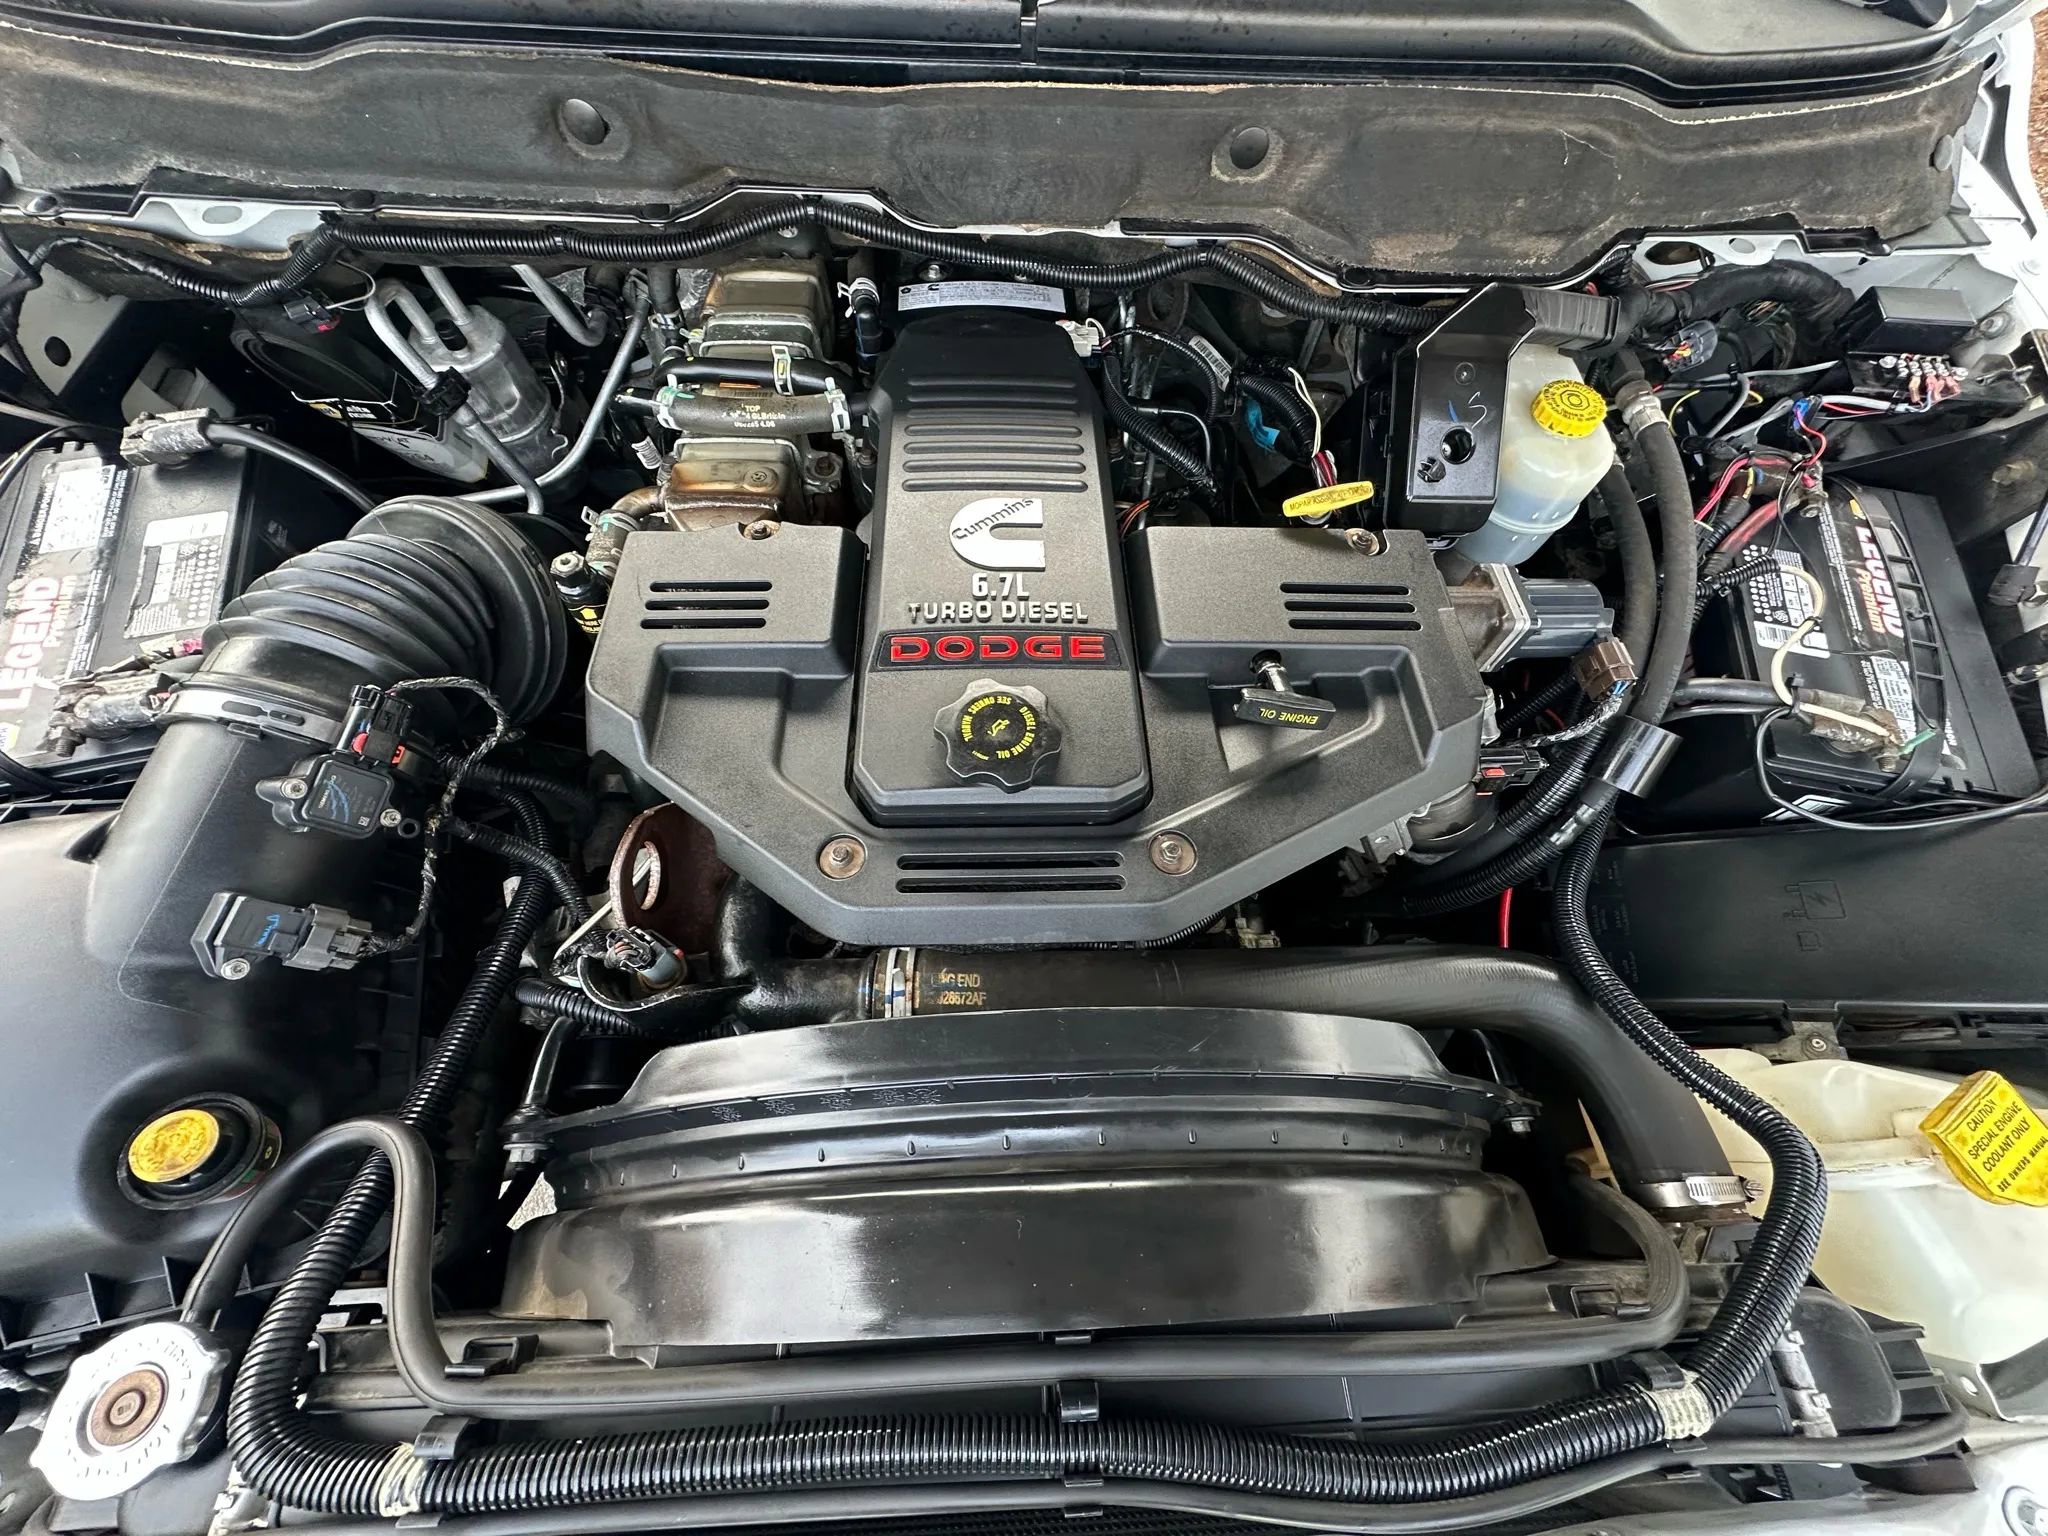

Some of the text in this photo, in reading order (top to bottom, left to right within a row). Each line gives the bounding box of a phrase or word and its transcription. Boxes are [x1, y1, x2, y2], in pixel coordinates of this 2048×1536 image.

[951, 498, 1034, 540] Cummins
[971, 572, 1030, 600] 6.7L
[1856, 568, 1886, 635] Premium
[43, 574, 79, 649] Premium
[908, 600, 1089, 624] TURBO DIESEL
[0, 577, 64, 711] LEGEND
[890, 635, 1106, 663] DODGE
[997, 696, 1012, 705] SEE
[1260, 708, 1319, 725] ENGINE OIL
[961, 715, 974, 742] MANUAL
[996, 706, 1037, 759] DIESEL ENGINE OIL
[957, 973, 981, 988] END
[1966, 1098, 1998, 1132] CAUTION
[1968, 1101, 2023, 1160] SPECIAL ENGINE
[1982, 1117, 2031, 1173] COOLANT ONLY
[1997, 1135, 2048, 1193] SEE OWNERS MANUAL
